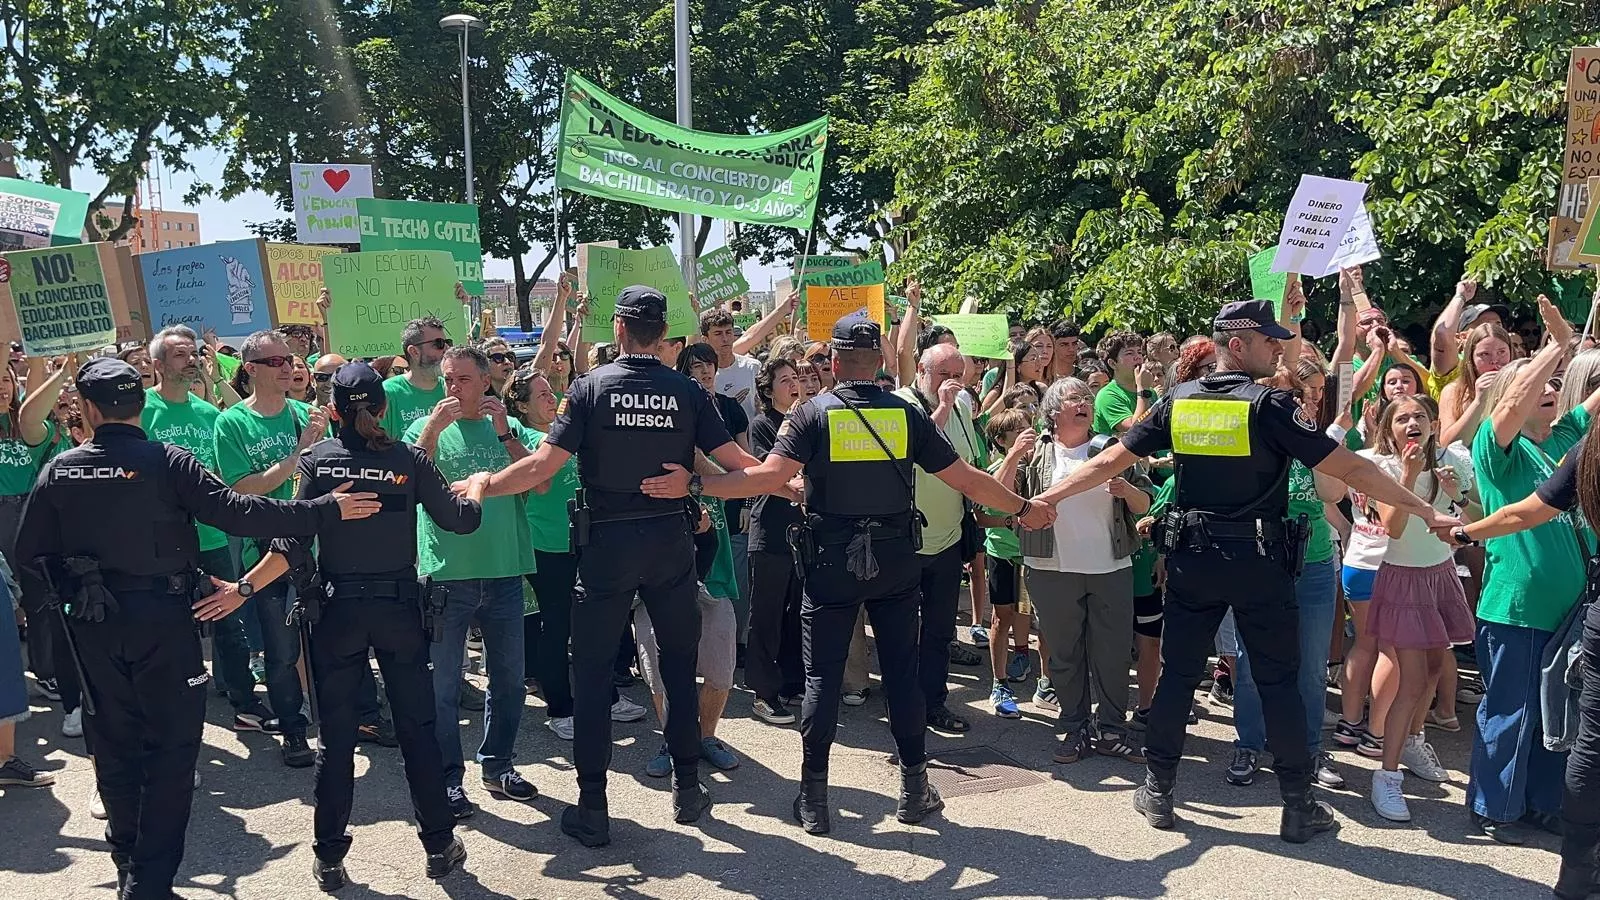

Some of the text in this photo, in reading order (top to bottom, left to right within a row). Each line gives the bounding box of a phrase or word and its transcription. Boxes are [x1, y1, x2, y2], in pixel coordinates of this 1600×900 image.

[1573, 106, 1594, 122] DE
[588, 116, 616, 138] LA
[1571, 150, 1592, 163] NO
[642, 157, 666, 175] AL
[669, 162, 770, 192] CONCIERTO
[772, 176, 795, 196] DEL
[579, 165, 807, 219] BACHILLERATO Y 0-3 AÑOS!
[1307, 199, 1343, 211] DINERO
[359, 215, 481, 243] EL TECHO GOTEA
[1292, 225, 1331, 237] PARA LA
[31, 252, 78, 286] NO!
[333, 254, 432, 275] SIN ESCUELA
[600, 250, 634, 279] Profes
[722, 265, 738, 280] NO
[19, 283, 105, 307] AL CONCIERTO
[355, 275, 429, 297] NO HAY
[22, 300, 109, 324] EDUCATIVO EN
[356, 301, 422, 325] PUEBLO
[23, 317, 112, 341] BACHILLERATO
[117, 382, 137, 391] CNP
[350, 392, 368, 401] CNP
[610, 393, 679, 411] POLICIA
[615, 413, 674, 428] HUESCA
[54, 468, 127, 480] POLICIA
[316, 467, 397, 481] POLICIA
